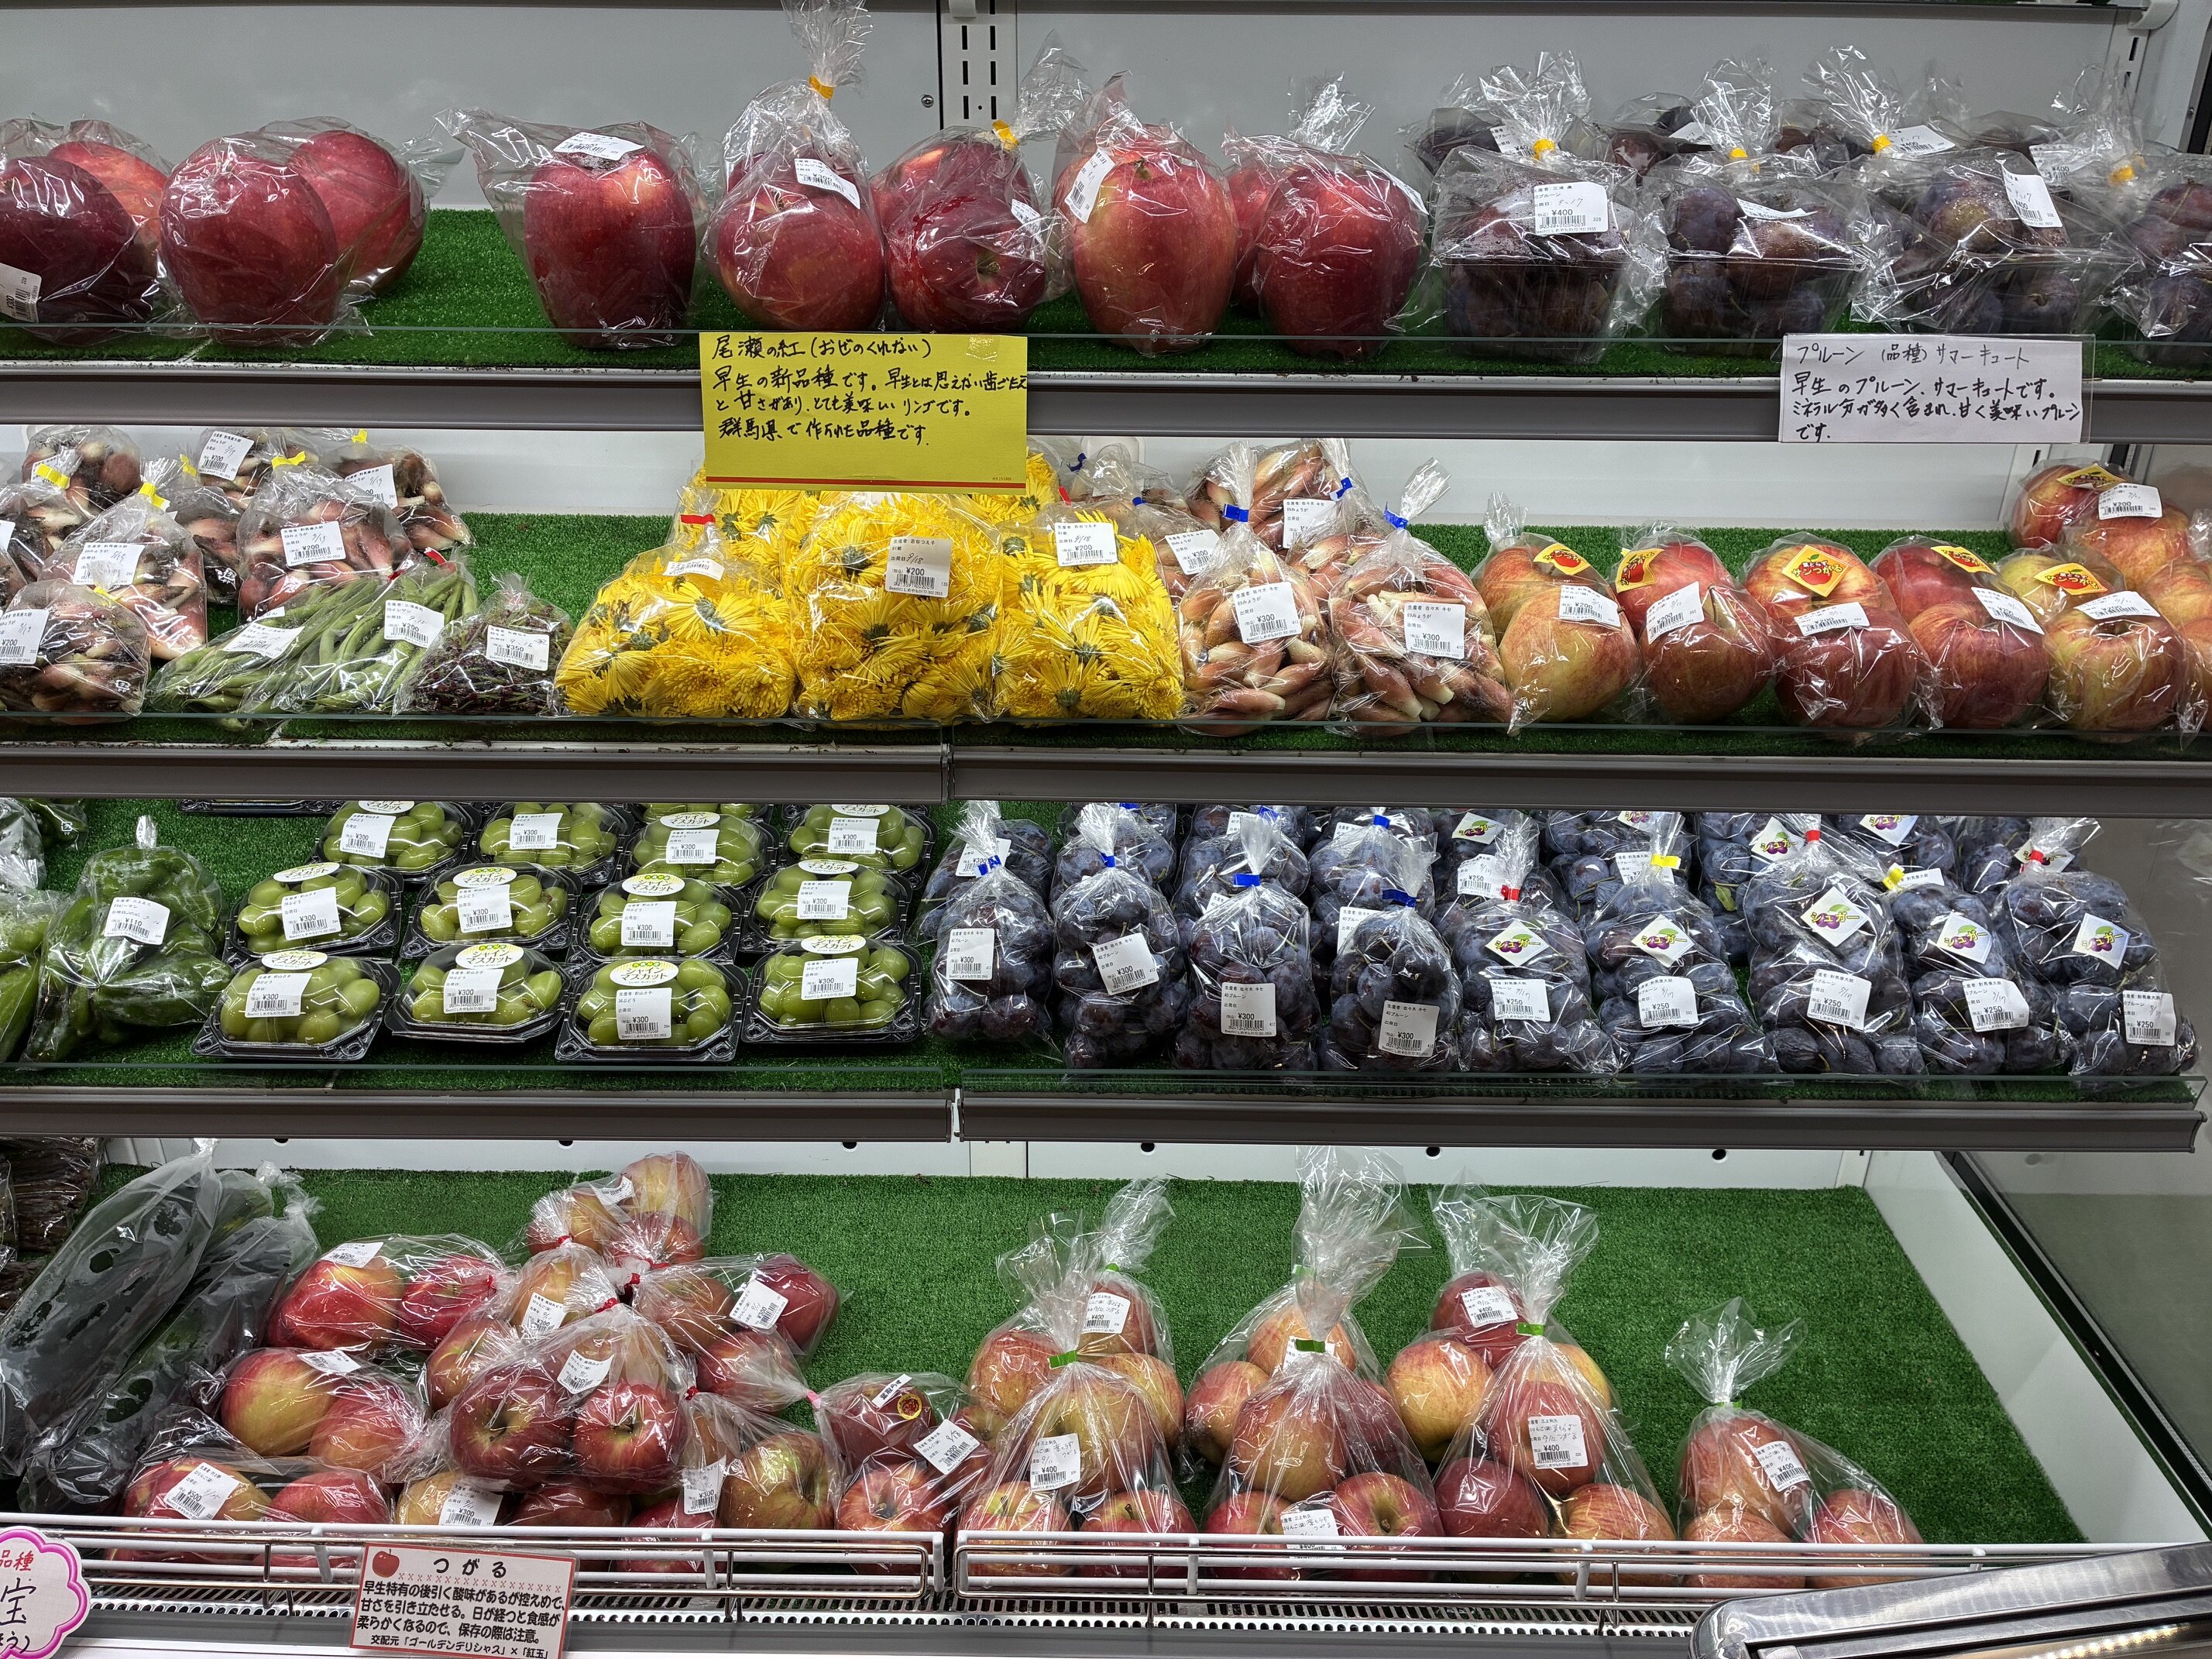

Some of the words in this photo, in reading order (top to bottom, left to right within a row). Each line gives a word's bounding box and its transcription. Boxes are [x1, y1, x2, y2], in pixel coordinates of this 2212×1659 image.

[2015, 200, 2028, 210] ¥400
[1798, 343, 1865, 366] プルーン
[1881, 343, 1928, 364] (品種)
[1936, 344, 2029, 369] サマーキュート
[906, 567, 925, 576] ¥200
[1791, 562, 1843, 577] サンつがる
[1256, 613, 1276, 623] ¥300
[402, 623, 419, 632] ¥200
[1422, 632, 1440, 641] ¥300
[1760, 838, 1798, 852] シュガー
[125, 917, 143, 927] ¥110
[300, 914, 317, 922] ¥300
[1810, 911, 1860, 923] シュガー
[1641, 934, 1688, 945] シュガー
[1944, 930, 1988, 946] シュガー
[2082, 931, 2124, 950] シュガー
[1494, 938, 1541, 950] シュガー
[472, 950, 510, 958] シャイン
[1117, 965, 1134, 976] ¥300
[1823, 997, 1842, 1008] ¥250
[1984, 1005, 2003, 1015] ¥250
[756, 1307, 768, 1320] ¥300
[537, 1318, 551, 1327] ¥300
[943, 1444, 957, 1456] ¥300
[1778, 1463, 1795, 1472] ¥400
[187, 1489, 202, 1502] ¥500
[699, 1489, 715, 1498] ¥300
[459, 1507, 475, 1516] ¥300
[433, 1558, 507, 1578] つがる
[363, 1581, 565, 1611] 早生特有の後引く酸味があるが控えめで、
[361, 1598, 560, 1626] 甘さを引き立たせる。日が経つと食感が
[356, 1615, 540, 1644] 柔らかくなるので、保存の際は注意。
